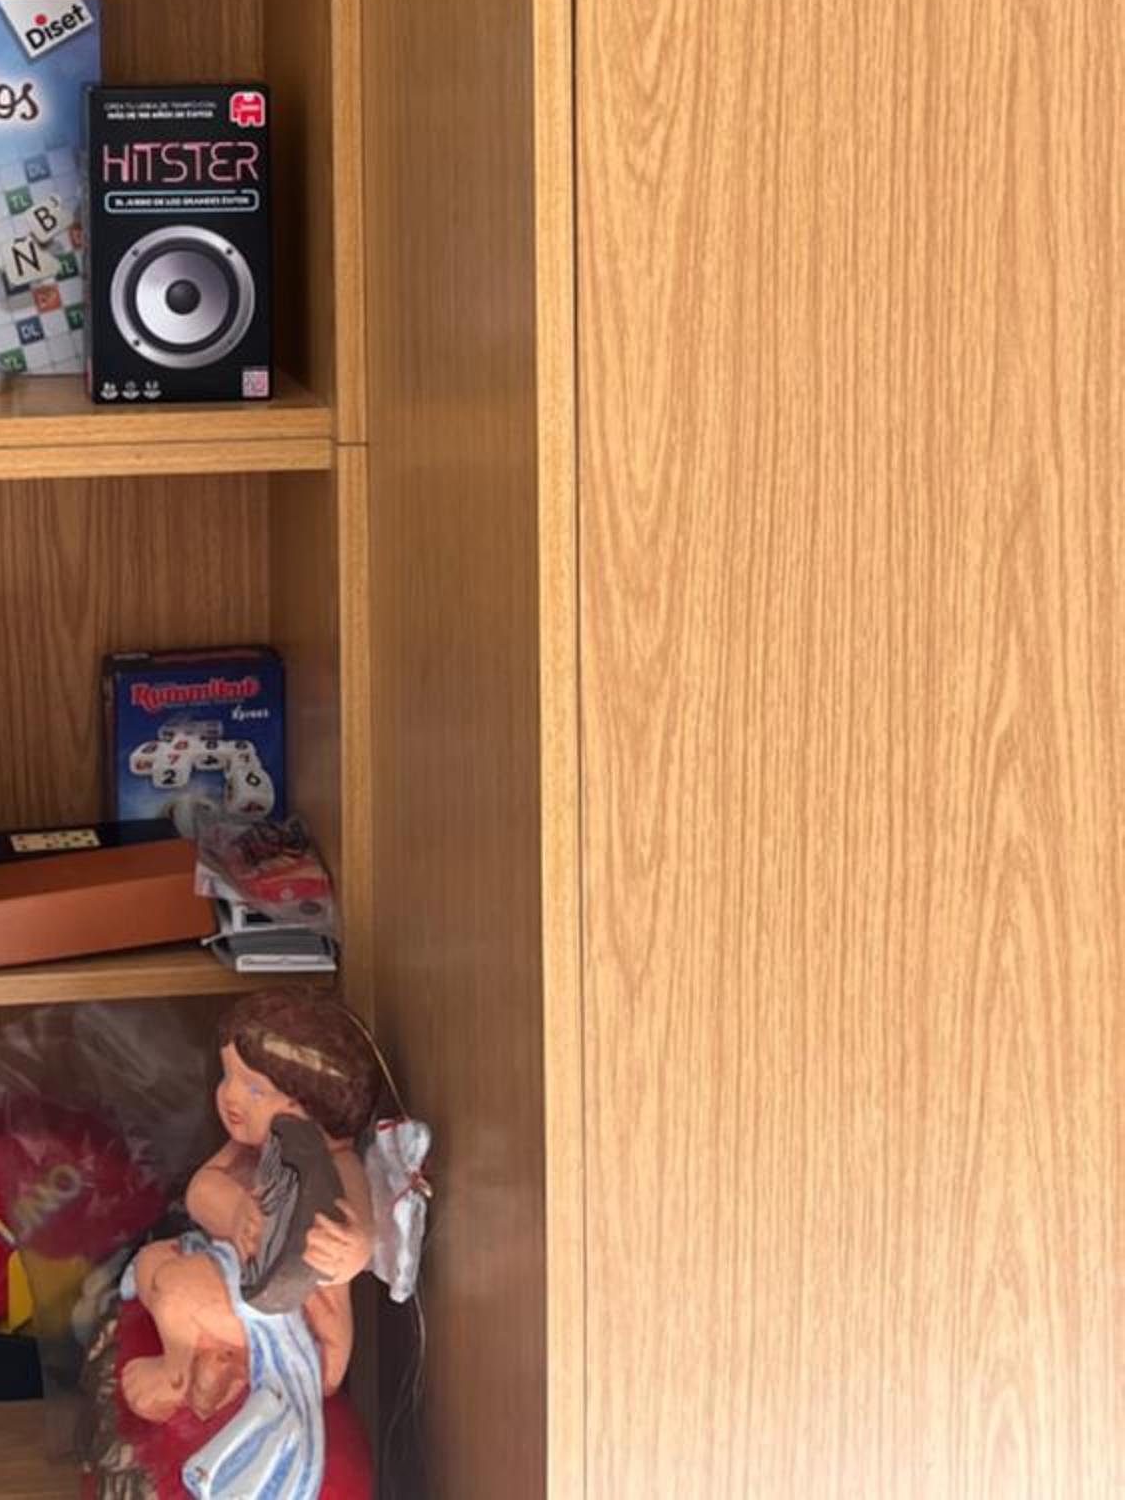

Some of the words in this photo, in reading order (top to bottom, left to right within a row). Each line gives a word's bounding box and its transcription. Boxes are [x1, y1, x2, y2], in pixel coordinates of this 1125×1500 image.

[24, 2, 91, 54] Diset
[102, 140, 260, 184] HITSTER
[33, 205, 58, 232] B
[161, 769, 177, 785] 2
